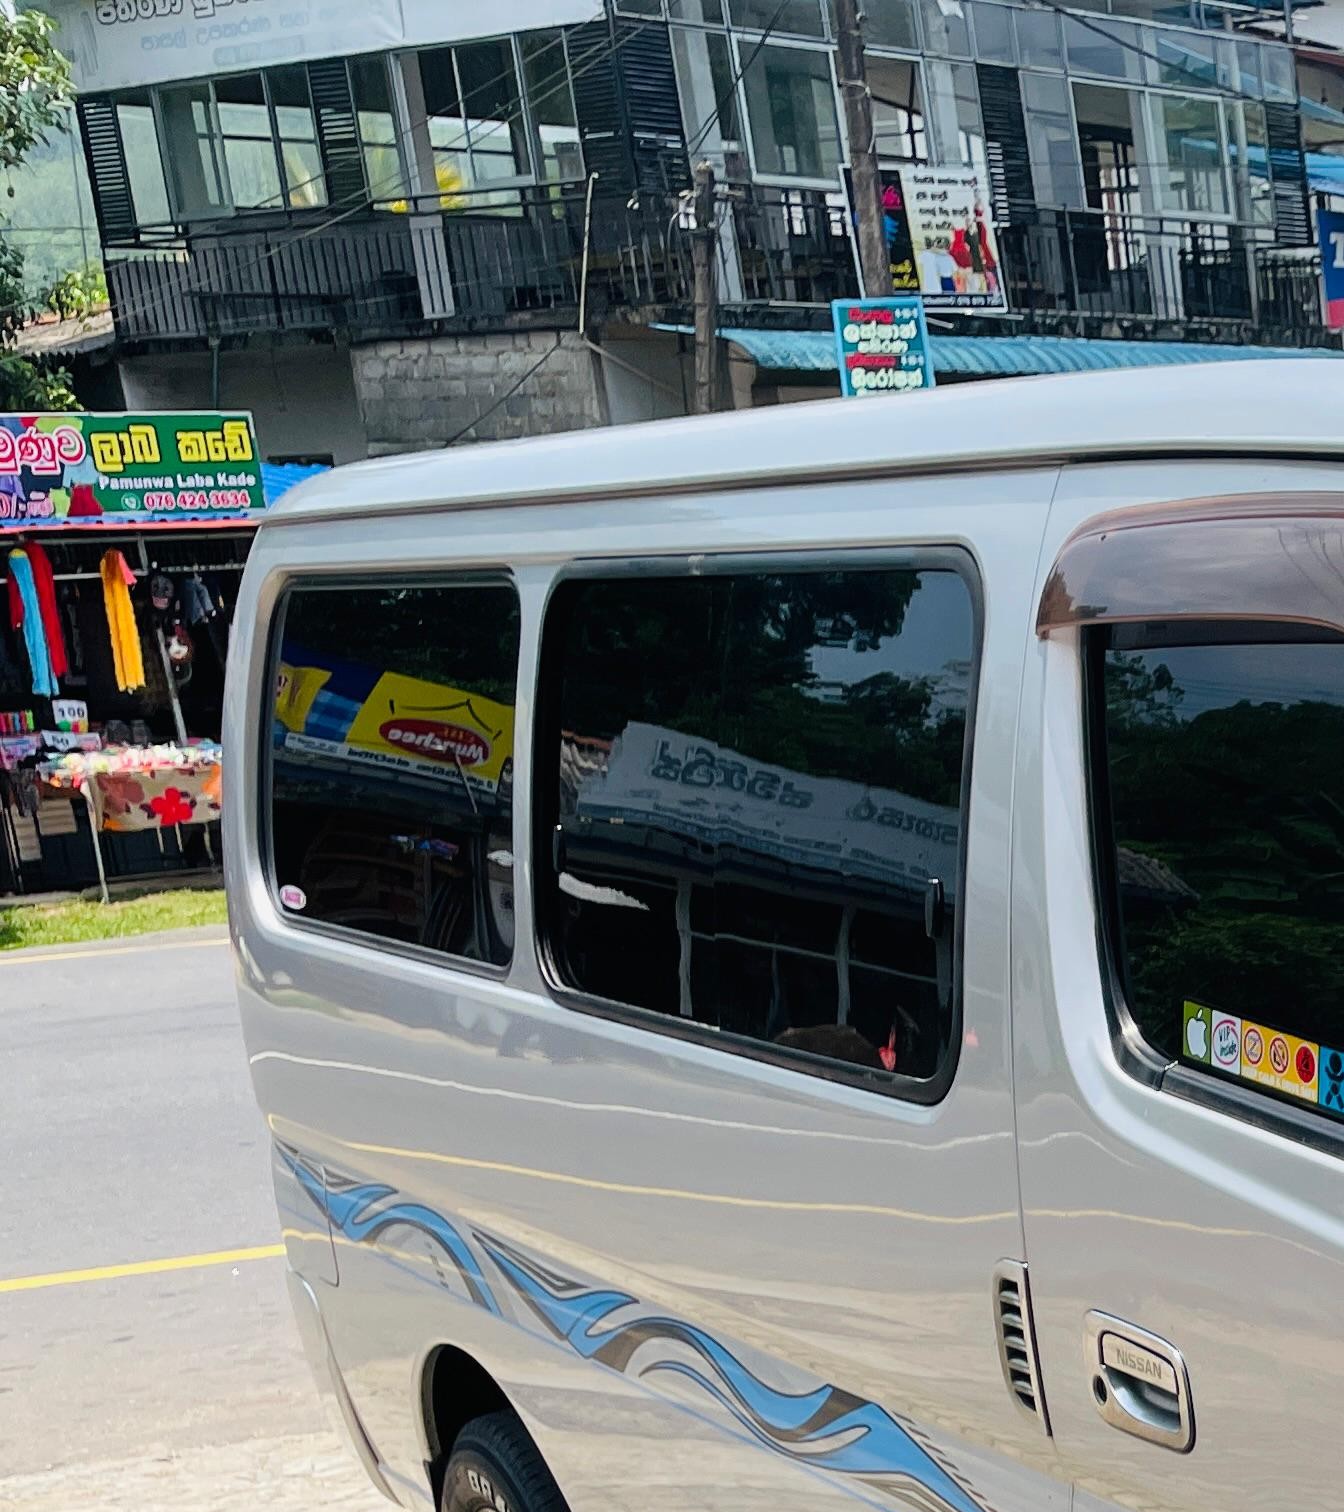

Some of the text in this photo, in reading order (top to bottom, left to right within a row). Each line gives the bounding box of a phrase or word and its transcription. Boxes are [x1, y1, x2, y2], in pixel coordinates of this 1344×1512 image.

[90, 425, 160, 472] ලාබ
[99, 472, 256, 490] Pamunwa Laba Kade
[144, 492, 175, 510] 076
[177, 491, 209, 509] 424
[1116, 1347, 1162, 1380] NISSAN
